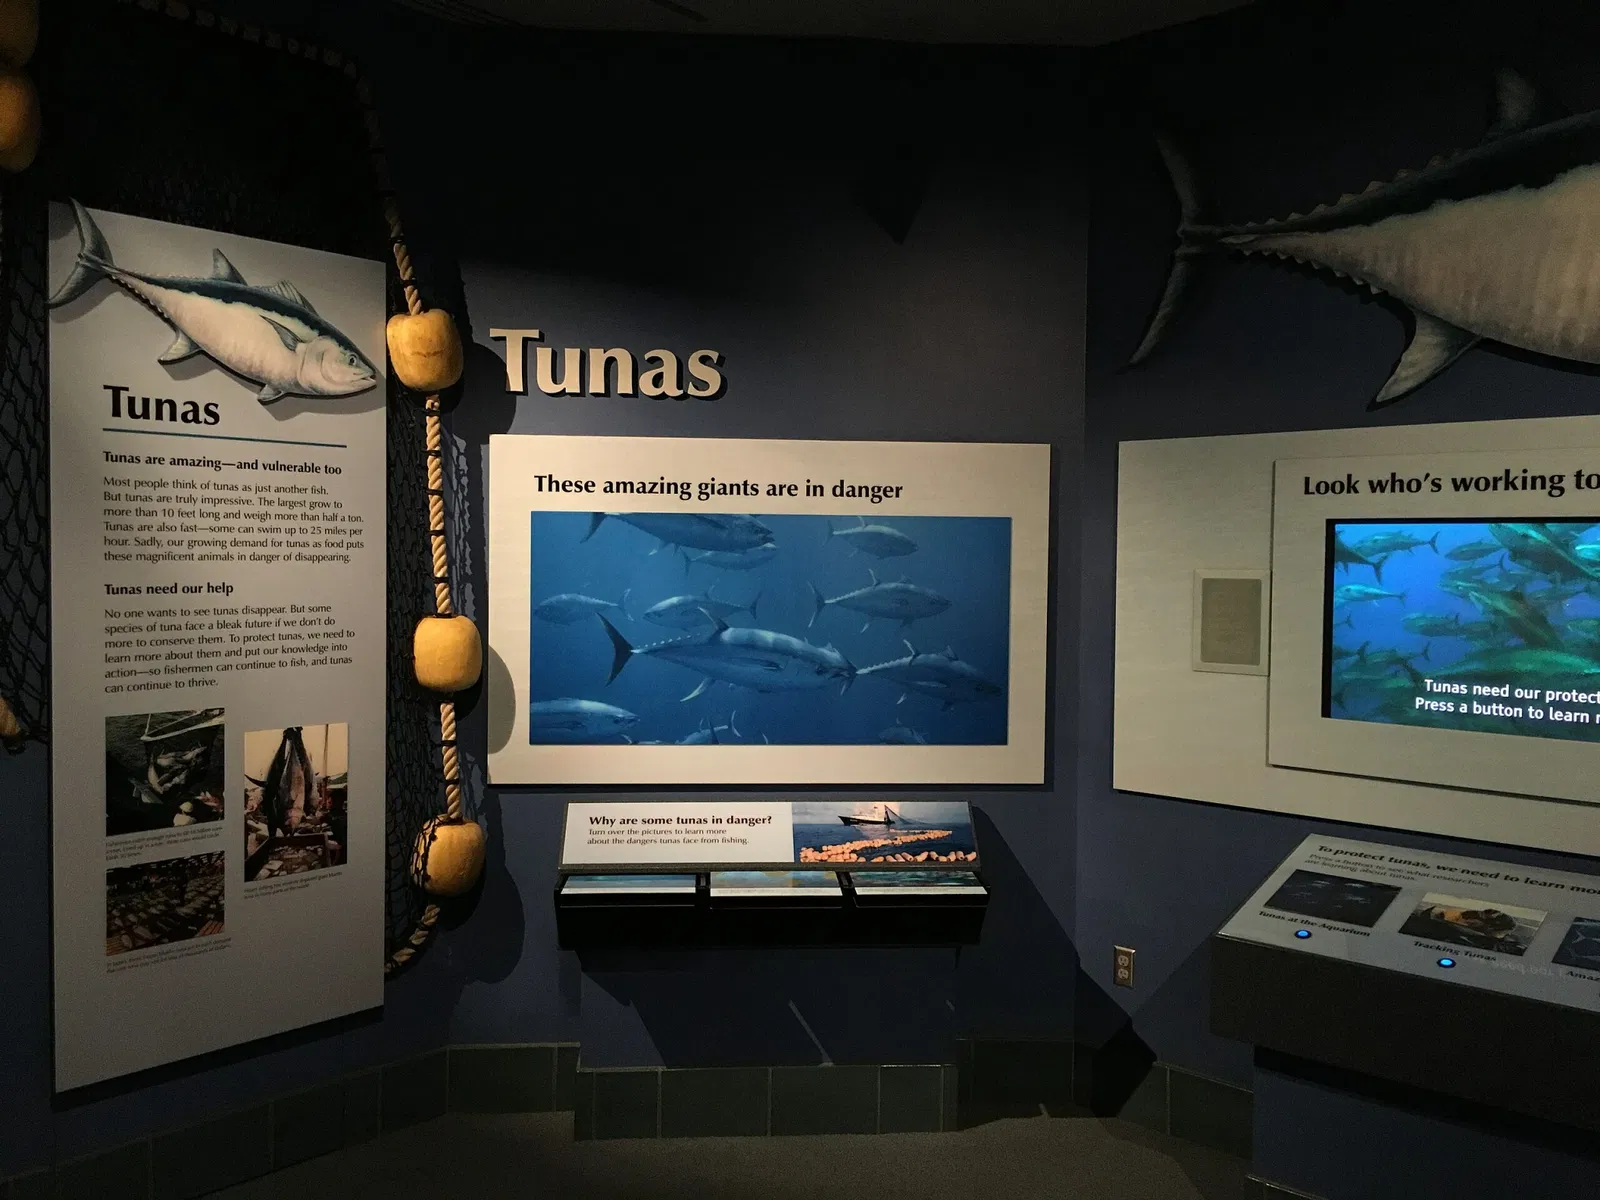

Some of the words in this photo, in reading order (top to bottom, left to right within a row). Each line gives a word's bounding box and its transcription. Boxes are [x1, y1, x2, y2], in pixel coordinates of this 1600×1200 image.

[490, 328, 724, 397] Tunas
[103, 384, 220, 426] Tunas
[103, 450, 140, 464] Tunas
[146, 456, 165, 466] are
[262, 458, 320, 473] vulnerable
[325, 463, 341, 474] too
[104, 476, 130, 488] Most
[134, 477, 169, 491] people
[172, 478, 197, 490] think
[200, 479, 210, 490] of
[214, 481, 239, 491] tunas
[242, 484, 252, 492] as
[255, 482, 271, 494] just
[274, 481, 308, 493] another
[311, 482, 328, 494] fish.
[534, 474, 596, 495] These
[603, 477, 692, 501] amazing
[698, 479, 759, 502] giants
[766, 482, 798, 498] are
[806, 480, 824, 498] in
[832, 478, 903, 503] danger
[1304, 474, 1360, 495] Look
[1451, 468, 1565, 498] working
[104, 490, 121, 501] But
[125, 492, 155, 502] tunas
[156, 495, 172, 503] are
[176, 492, 198, 506] truly
[201, 495, 254, 508] impressive.
[258, 494, 275, 506] The
[278, 495, 306, 509] largest
[309, 500, 331, 510] grow
[334, 499, 342, 508] to
[104, 520, 134, 531] Tunas
[157, 520, 177, 532] also
[258, 524, 282, 534] swim
[285, 526, 296, 536] up
[299, 525, 308, 534] to
[310, 523, 322, 534] 25
[325, 524, 347, 535] miles
[350, 528, 363, 537] per
[104, 535, 130, 546] hour.
[134, 535, 163, 549] Sadly,
[188, 537, 227, 549] growing
[230, 536, 268, 547] demand
[271, 536, 283, 547] for
[286, 538, 310, 548] tunas
[312, 540, 322, 548] as
[325, 537, 344, 548] food
[346, 539, 364, 550] puts
[104, 549, 132, 560] these
[136, 550, 194, 563] magnificent
[198, 550, 235, 561] animals
[238, 552, 246, 561] in
[249, 550, 280, 563] danger
[283, 550, 292, 561] of
[295, 550, 351, 563] disappearing.
[104, 581, 142, 594] Tunas
[146, 581, 178, 594] need
[182, 584, 203, 593] our
[207, 580, 234, 596] help
[105, 606, 120, 618] No
[147, 607, 177, 617] wants
[181, 606, 190, 616] to
[194, 608, 210, 616] see
[214, 605, 238, 615] tunas
[242, 602, 287, 617] disappear.
[291, 602, 304, 613] But
[308, 605, 331, 613] some
[105, 640, 133, 648] more
[136, 637, 147, 646] to
[150, 637, 195, 646] conserve
[198, 632, 226, 644] them.
[229, 631, 240, 643] To
[243, 632, 275, 644] protect
[278, 630, 304, 643] tunas,
[323, 627, 344, 639] need
[347, 628, 355, 638] to
[105, 650, 131, 662] learn
[135, 653, 162, 661] more
[165, 647, 193, 660] about
[197, 646, 221, 658] them
[225, 645, 242, 657] and
[245, 646, 260, 658] put
[263, 647, 279, 655] our
[282, 641, 329, 656] knowledge
[332, 642, 348, 652] into
[164, 661, 213, 674] fishermen
[216, 664, 233, 672] can
[236, 659, 276, 670] continue
[279, 658, 288, 668] to
[291, 656, 308, 670] fish,
[311, 654, 328, 666] and
[330, 655, 352, 665] tunas
[105, 685, 123, 693] can
[127, 680, 172, 692] continue
[175, 679, 185, 689] to
[189, 675, 218, 688] thrive.
[1424, 678, 1467, 695] Tunas
[1472, 680, 1509, 698] need
[1514, 686, 1541, 700] our
[1414, 696, 1454, 714] Press
[1458, 703, 1468, 715] a
[1472, 701, 1522, 719] button
[1527, 706, 1544, 721] to
[1548, 706, 1589, 724] learn
[590, 816, 616, 827] Why
[676, 817, 708, 825] tunas
[712, 817, 722, 825] in
[726, 816, 772, 827] danger?
[626, 837, 657, 846] dangers
[642, 829, 672, 837] pictures
[1333, 849, 1386, 861] protect
[1388, 856, 1431, 869] tunas,
[1436, 864, 1458, 872] we
[1460, 868, 1500, 879] need
[1504, 874, 1520, 882] to
[1524, 876, 1566, 889] learn
[1258, 911, 1286, 920] Tunas
[1318, 923, 1371, 936] Aquarium
[1413, 940, 1460, 956] Tracking
[1464, 950, 1497, 961] Tunas
